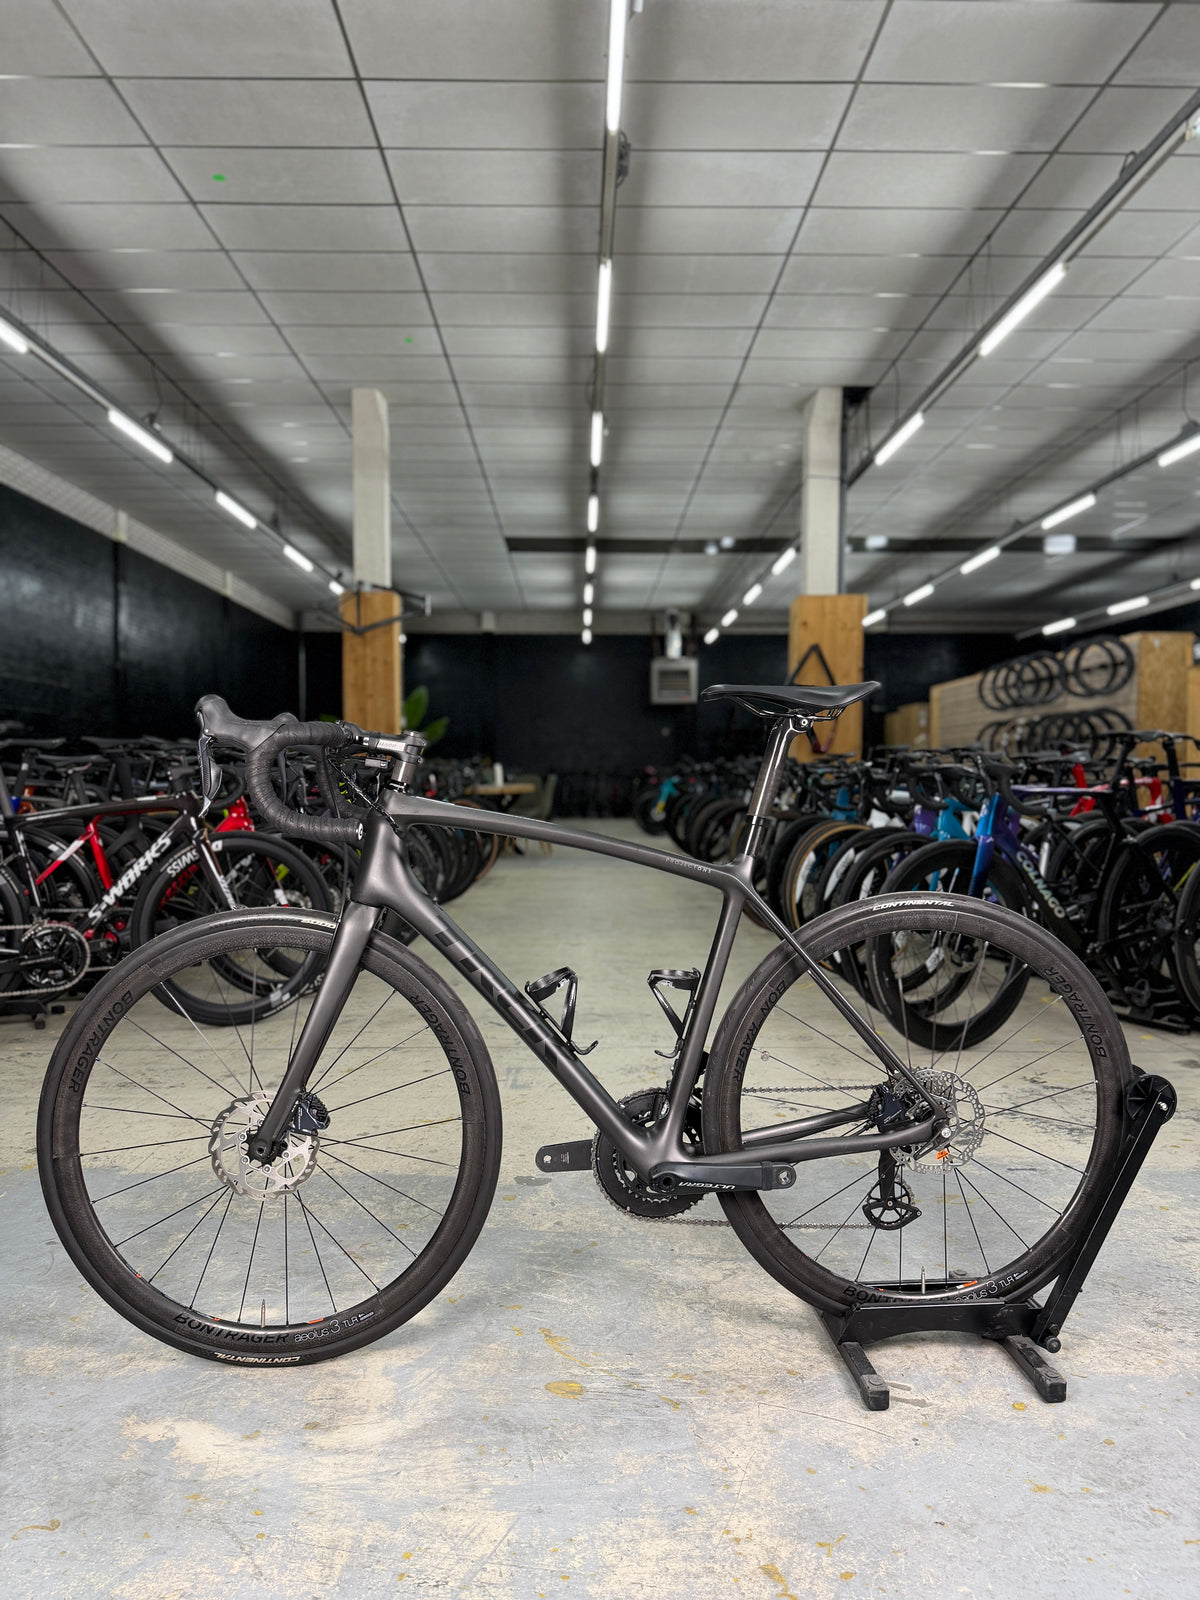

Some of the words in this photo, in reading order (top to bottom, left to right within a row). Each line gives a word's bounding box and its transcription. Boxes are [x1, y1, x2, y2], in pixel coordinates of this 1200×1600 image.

[88, 831, 172, 925] S-WORKS
[872, 899, 955, 911] CONTINENTAL
[1016, 851, 1066, 918] COLNAGO
[69, 990, 134, 1093] BONTRAGER
[411, 994, 471, 1095] BONTRAGER
[733, 980, 786, 1082] BONRAGER
[1044, 967, 1107, 1058] BONTRAGER
[678, 1181, 736, 1190] ULTEGRA
[986, 1280, 998, 1294] 3
[173, 1313, 289, 1343] BONTRAGER
[294, 1327, 330, 1343] aeolus
[329, 1319, 341, 1334] 3
[342, 1316, 359, 1328] TLR
[213, 1351, 301, 1364] CONTINENTAL
